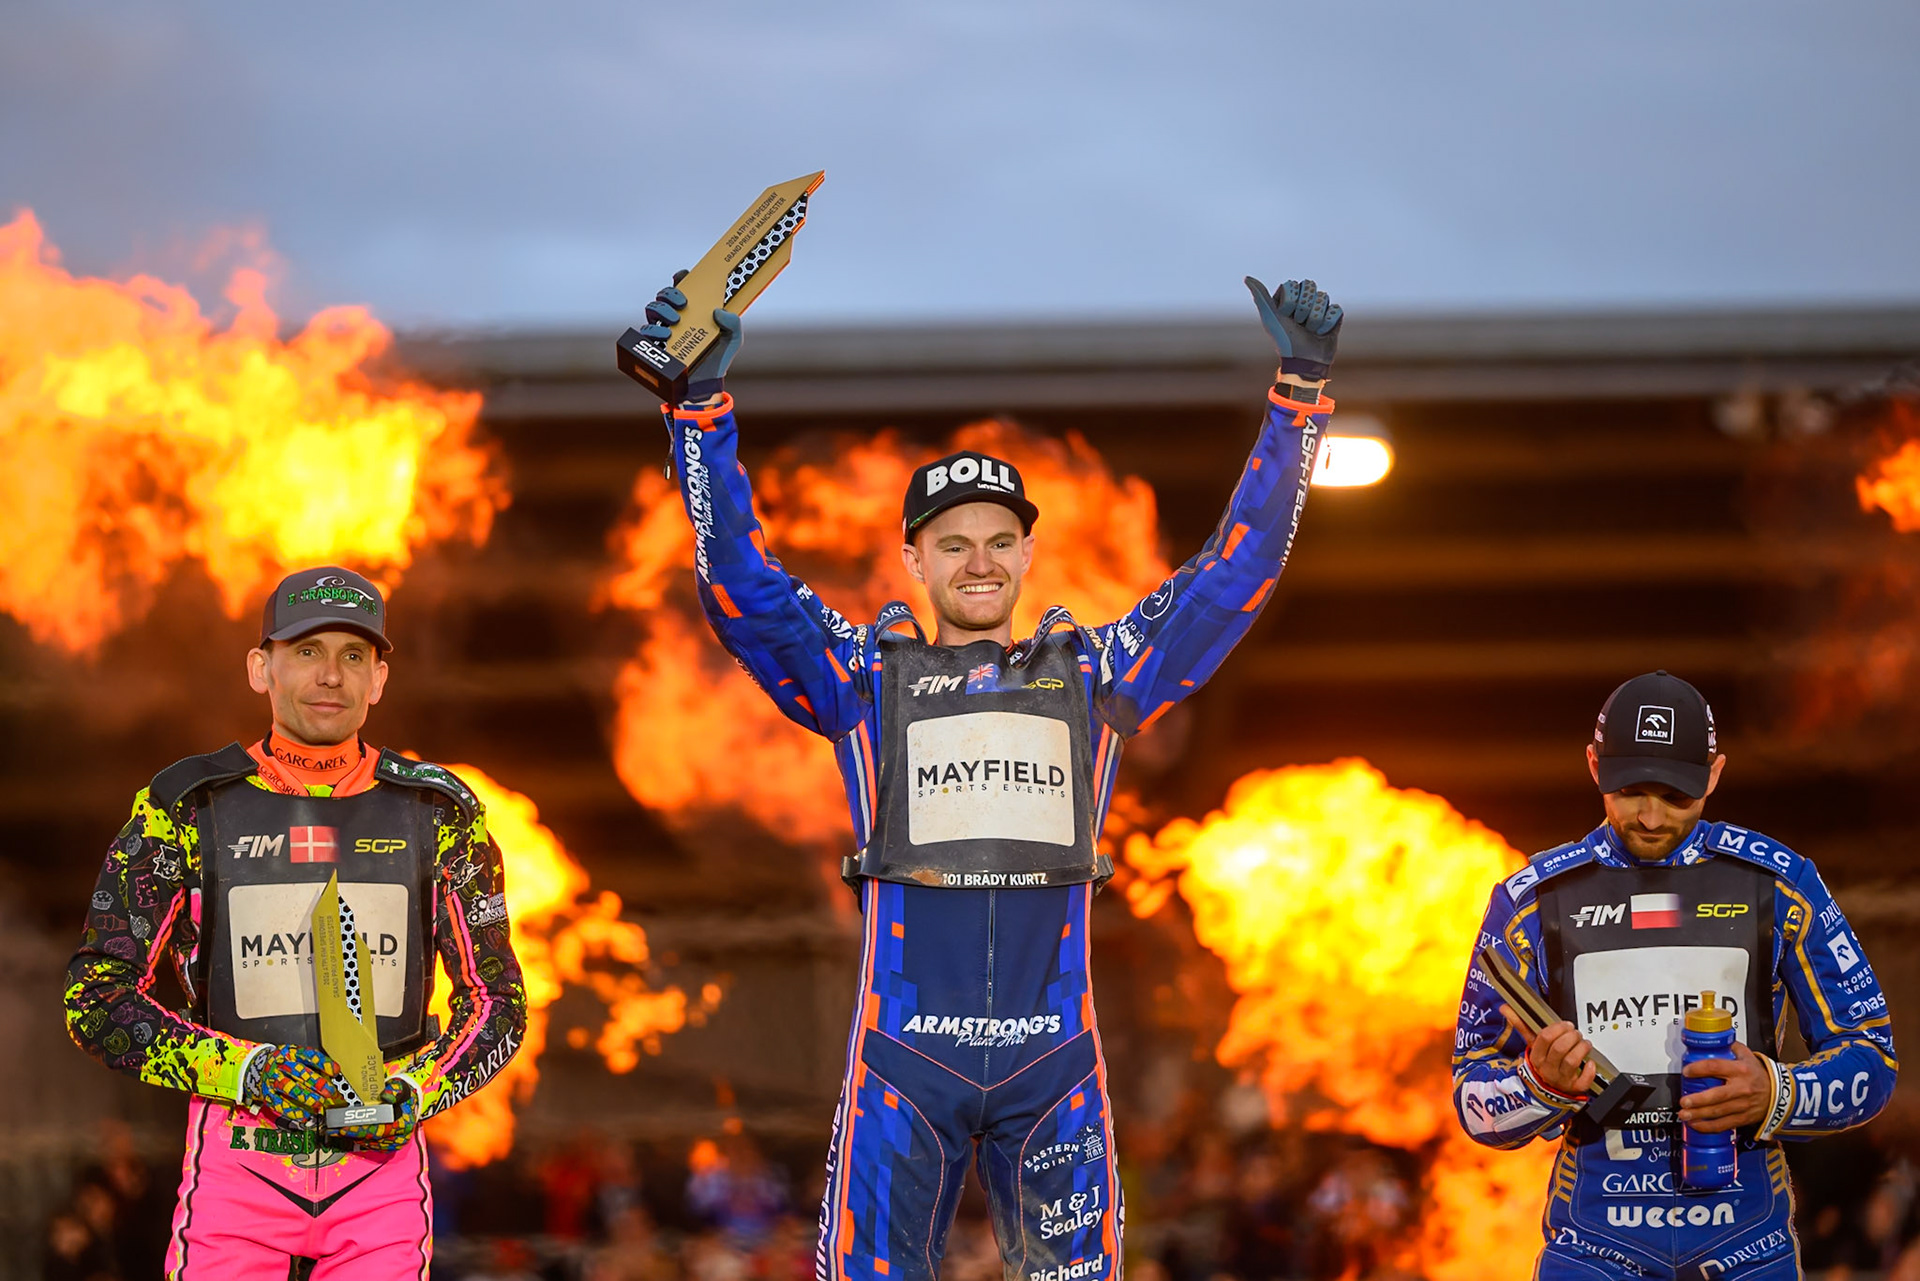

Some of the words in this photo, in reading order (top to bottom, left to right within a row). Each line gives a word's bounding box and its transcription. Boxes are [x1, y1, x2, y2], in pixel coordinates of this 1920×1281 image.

[724, 244, 742, 262] GRAND
[739, 234, 751, 247] PRIX
[749, 227, 758, 236] OF
[755, 197, 786, 229] MANCHESTER
[726, 234, 739, 247] 2026
[745, 216, 755, 227] FIM
[754, 192, 778, 217] SPEEDWAY
[635, 340, 671, 363] SGP
[671, 330, 692, 351] ROUND
[675, 328, 709, 360] WINNER
[926, 457, 1015, 497] BOLL
[908, 675, 964, 697] FIM
[1641, 729, 1668, 739] ORLEN
[275, 747, 348, 770] GARCAREK
[260, 765, 301, 796] GARCARE
[918, 759, 1065, 788] MAYFIELD
[918, 783, 987, 798] SPORTS
[1003, 783, 1065, 798] EVENTS
[227, 834, 285, 859] FIM
[354, 838, 407, 854] SGP
[1543, 847, 1587, 868] ORLEN
[1545, 862, 1562, 873] OIL
[964, 873, 1007, 886] BRADY
[1010, 873, 1048, 886] KURTZ
[1569, 903, 1627, 928] FIM
[1696, 903, 1749, 918] SGP
[241, 932, 398, 959] MAYLD
[242, 957, 313, 969] SPORTS
[1467, 981, 1479, 992] OIL
[1586, 993, 1739, 1024] MAYFIED
[902, 1014, 1062, 1036] ARMSTRONG'S
[1588, 1018, 1656, 1034] SPORTS
[367, 1055, 377, 1083] PLACE
[344, 1108, 377, 1120] SGP
[1625, 1112, 1673, 1124] ARTOSZ
[230, 1126, 250, 1150] E.
[254, 1127, 331, 1154] TRASB
[1024, 1143, 1080, 1169] EASTERN
[1034, 1154, 1074, 1173] POINT
[1040, 1198, 1063, 1221] M
[1068, 1192, 1089, 1211] &
[1088, 1185, 1101, 1208] J
[1040, 1208, 1103, 1240] Sealey
[1723, 1228, 1787, 1268] DRUTEX
[1029, 1253, 1104, 1281] Richard
